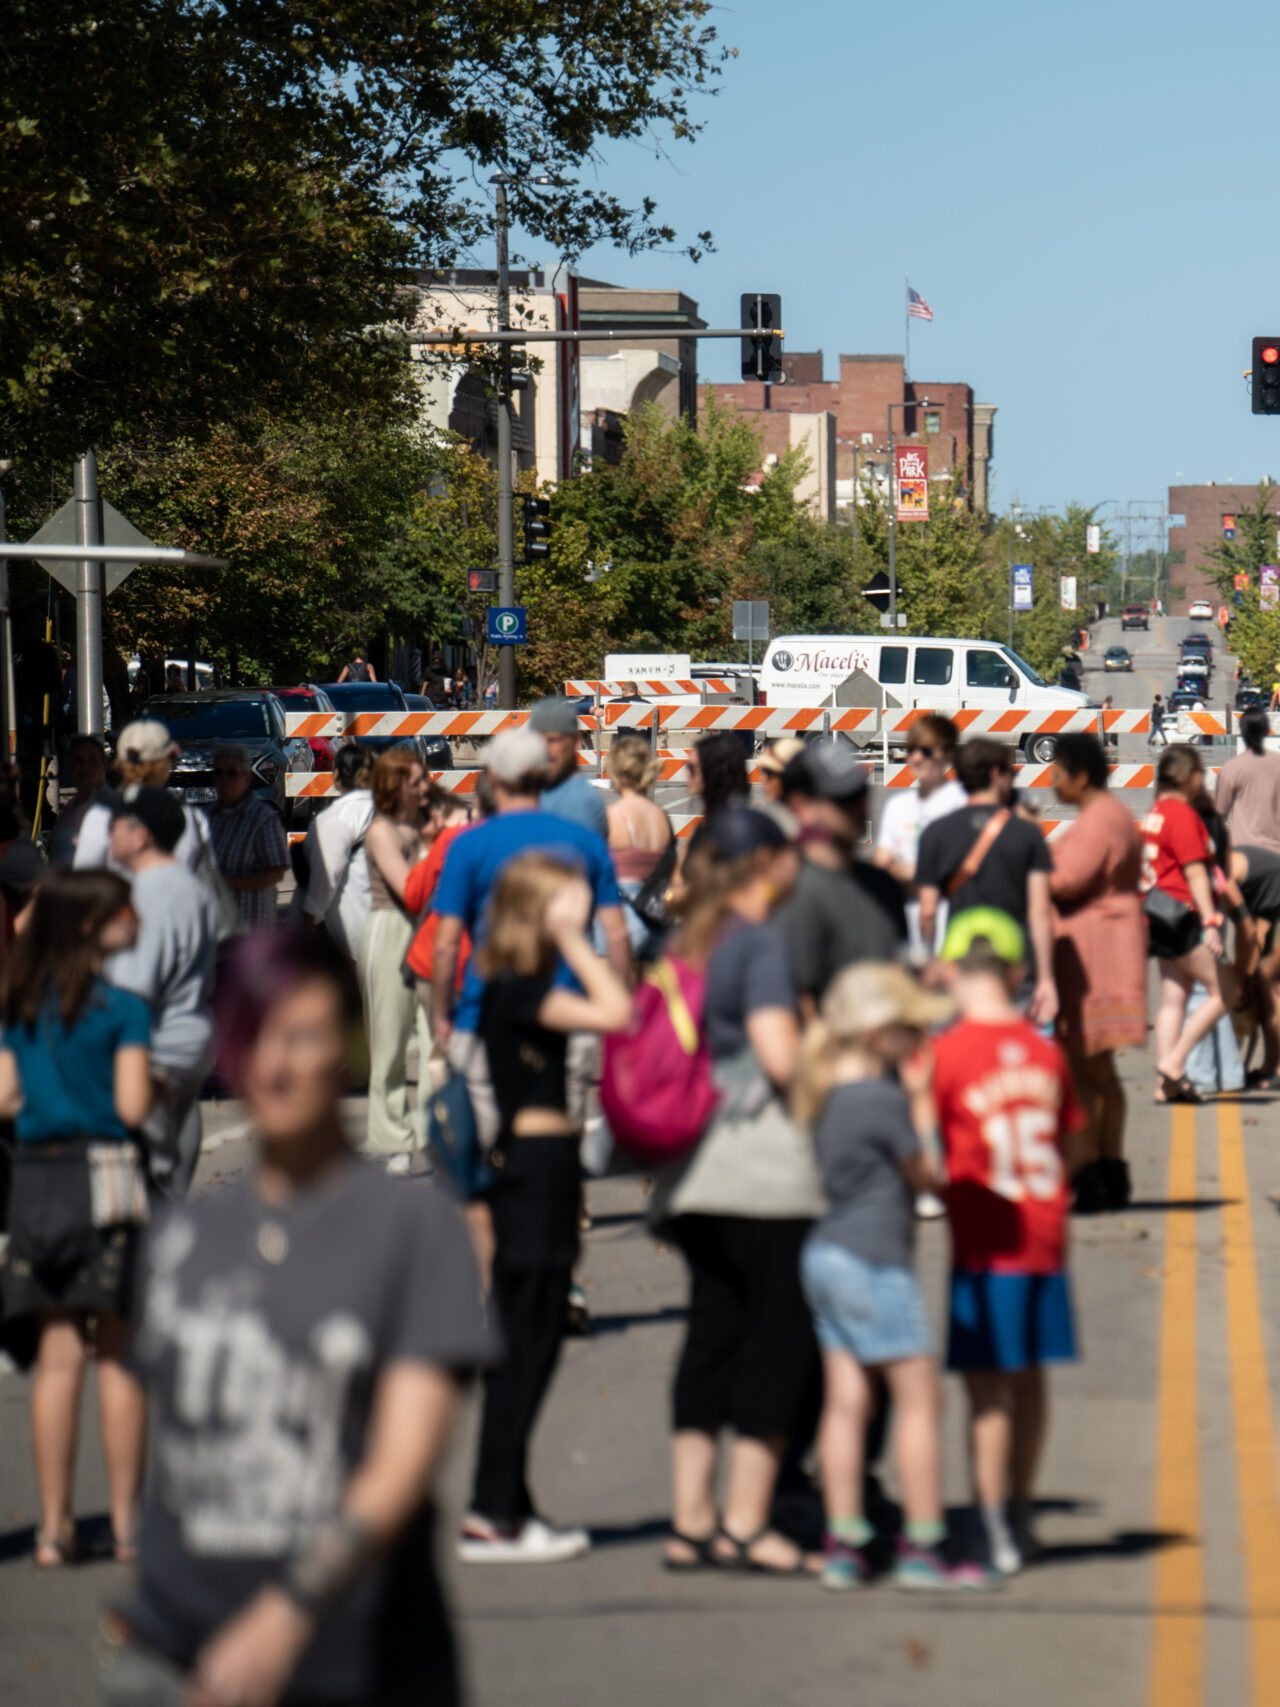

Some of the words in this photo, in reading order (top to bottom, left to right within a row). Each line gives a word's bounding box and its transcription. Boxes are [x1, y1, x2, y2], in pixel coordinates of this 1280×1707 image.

[502, 616, 514, 631] P
[794, 650, 870, 672] Maceli's
[982, 1110, 1064, 1202] 15
